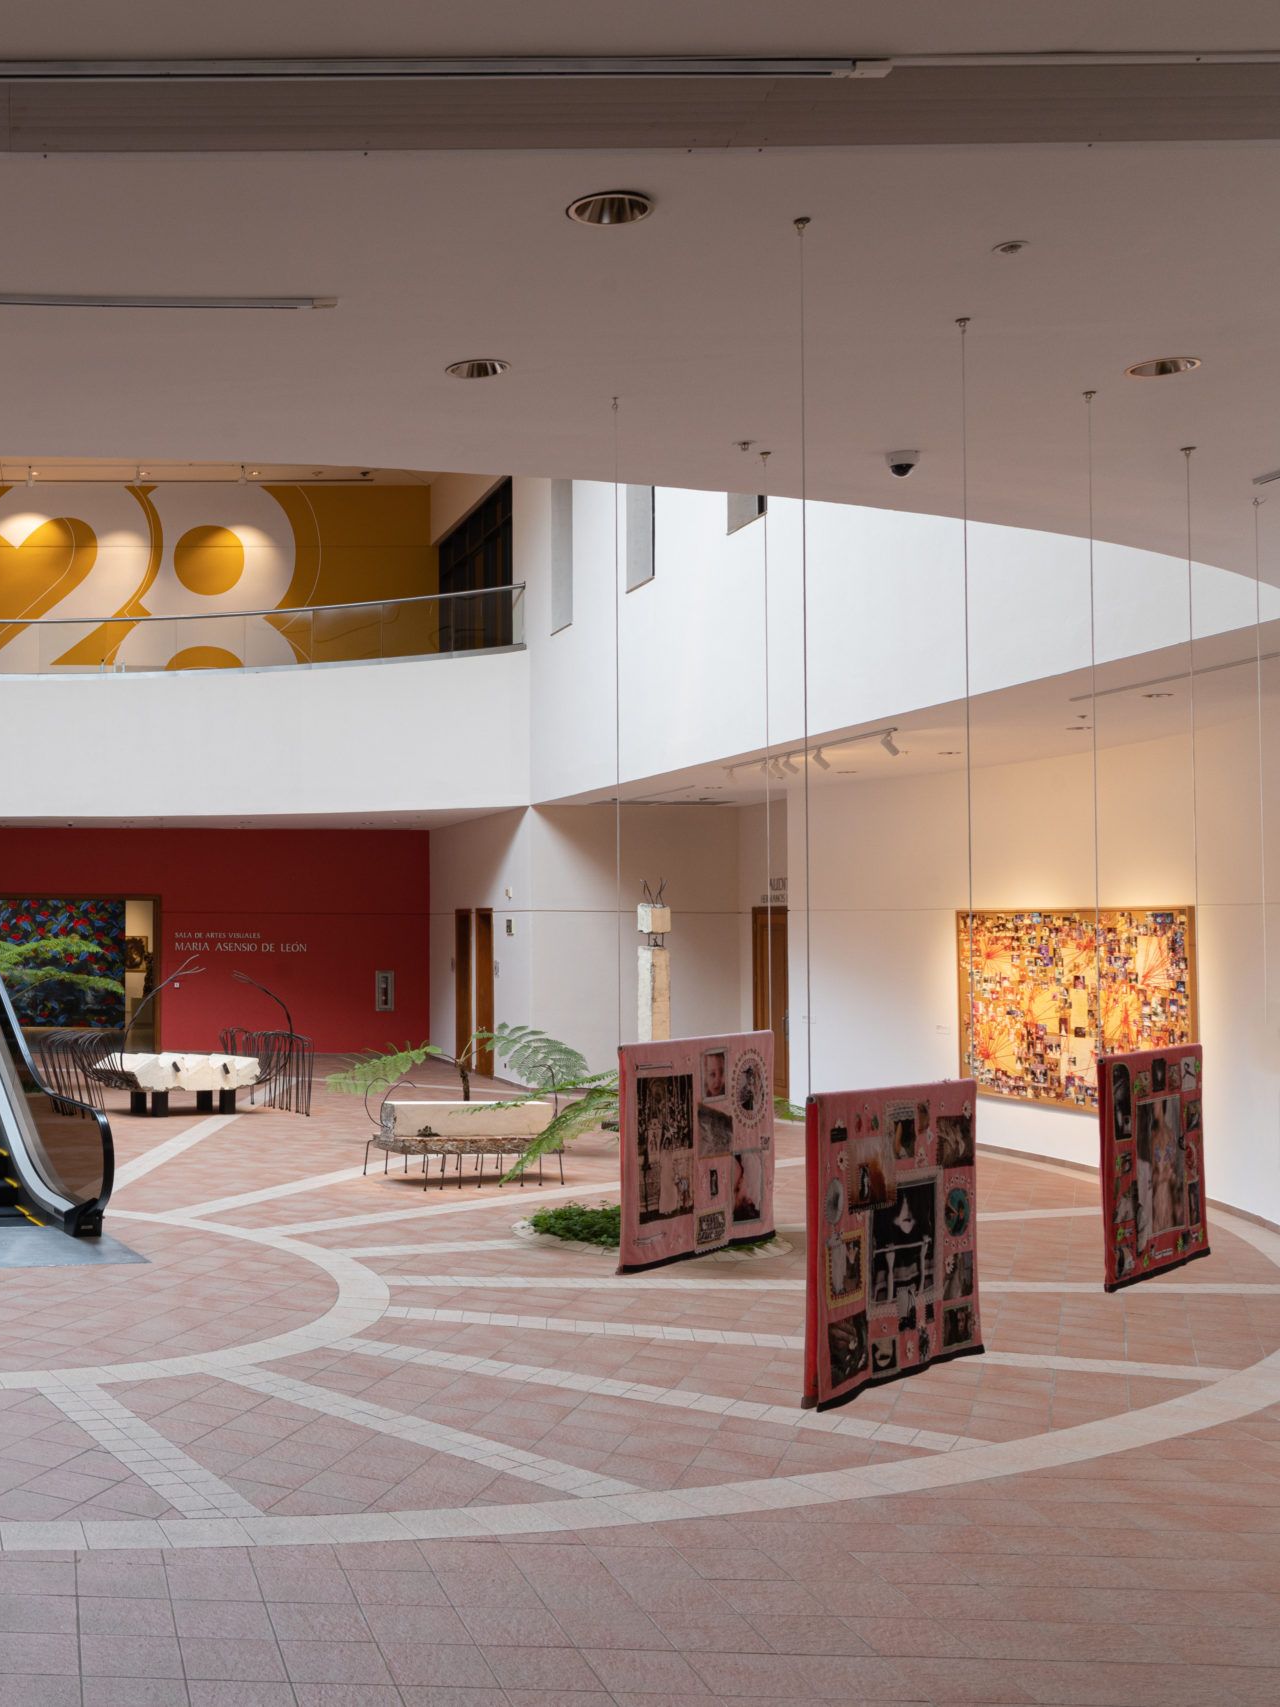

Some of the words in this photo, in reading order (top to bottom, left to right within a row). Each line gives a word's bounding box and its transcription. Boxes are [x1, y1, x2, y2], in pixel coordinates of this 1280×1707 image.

[215, 942, 258, 952] ASENSIO
[261, 943, 275, 952] DE
[280, 941, 307, 952] LEÓN
